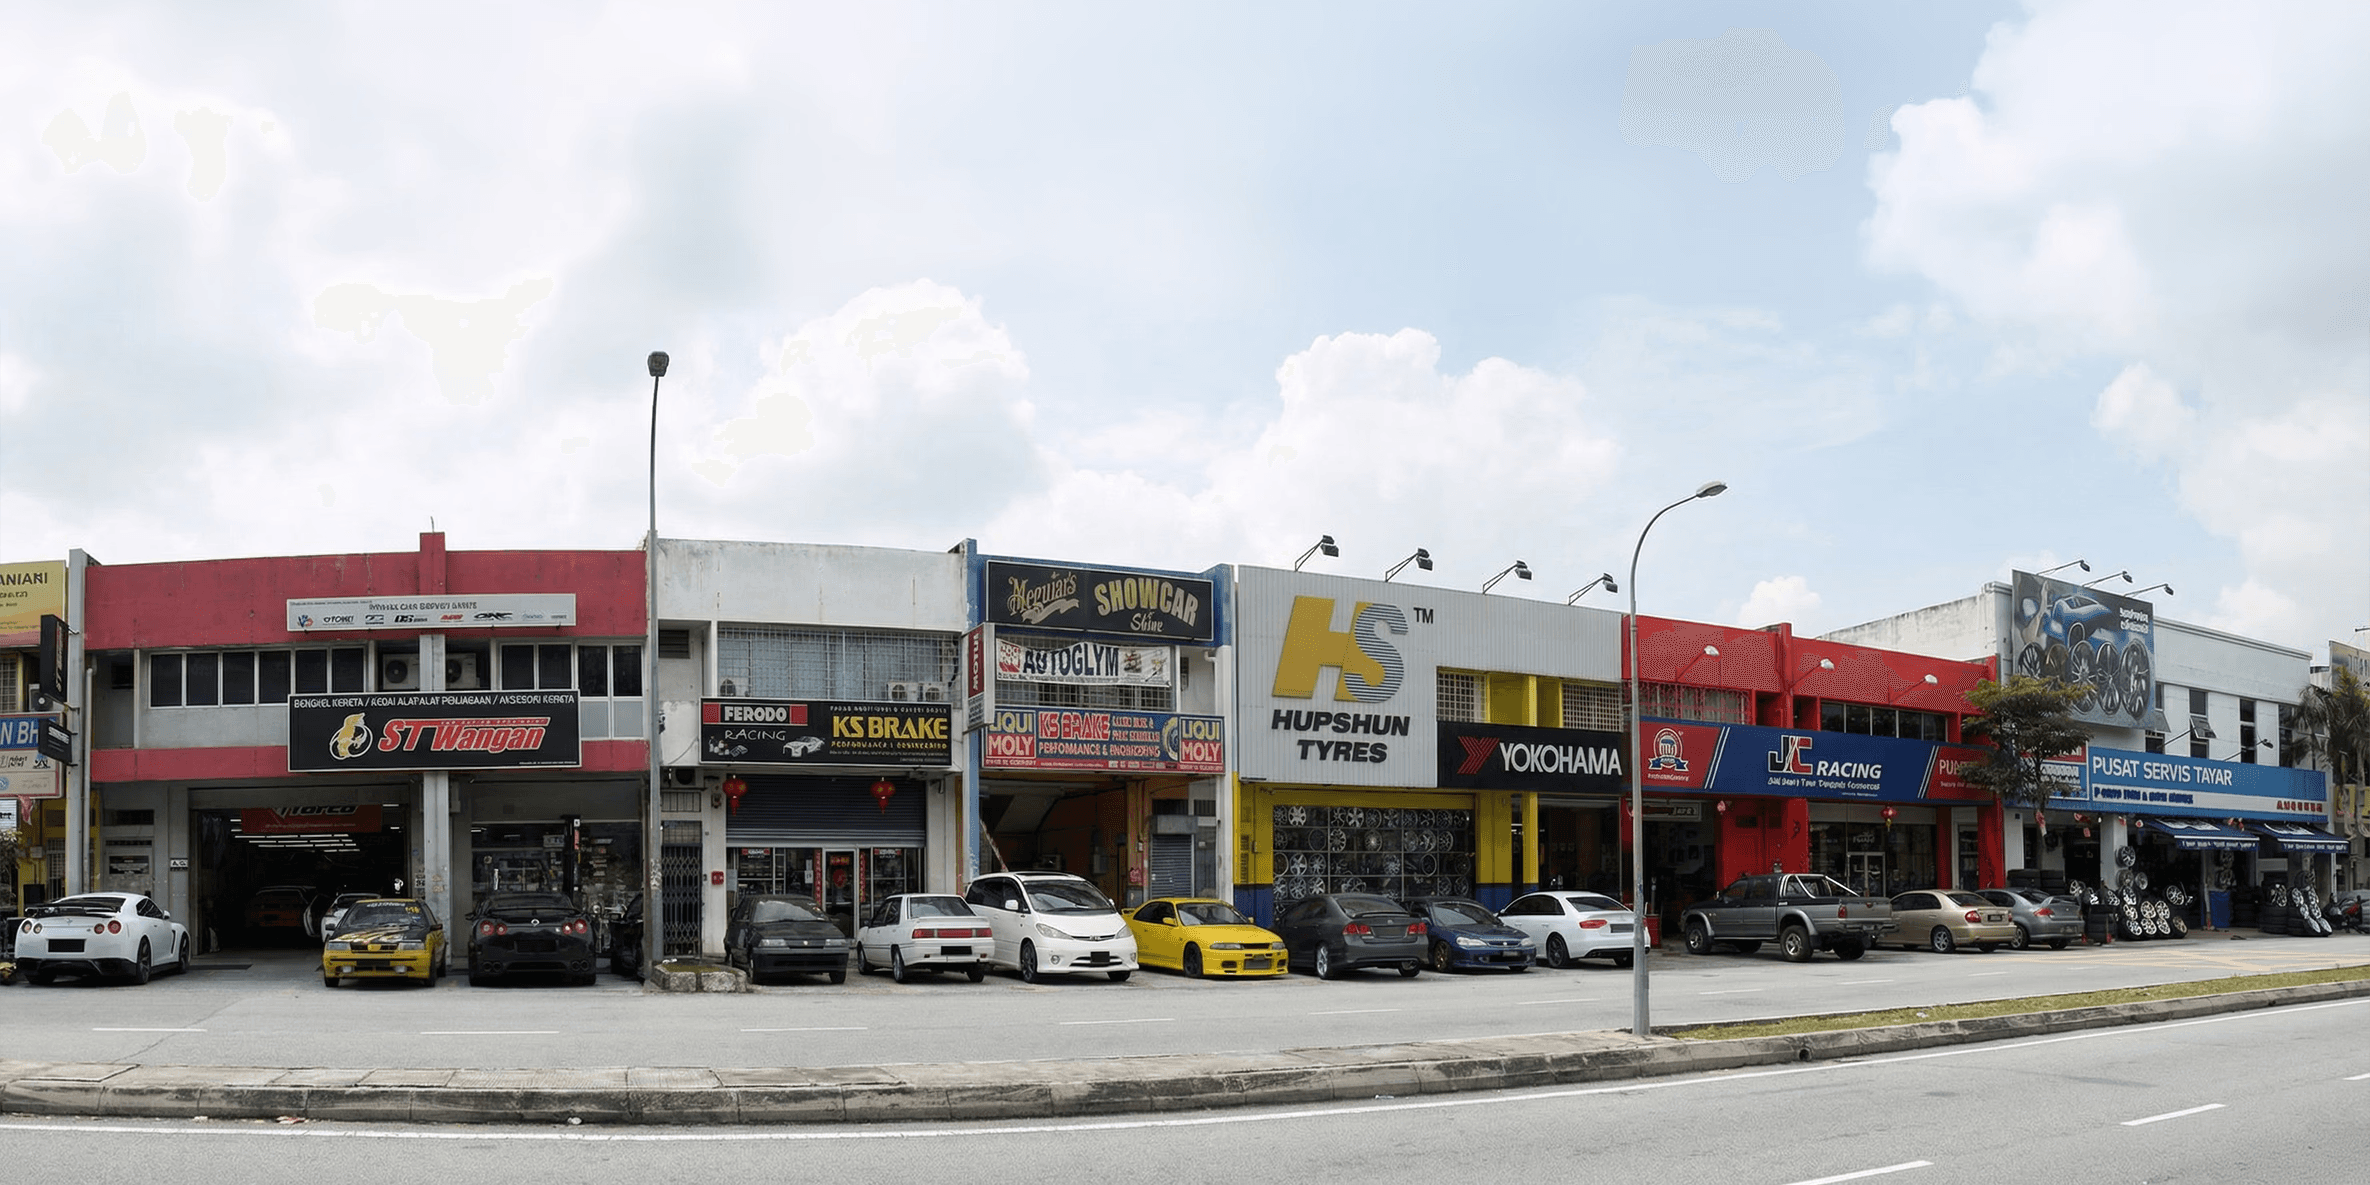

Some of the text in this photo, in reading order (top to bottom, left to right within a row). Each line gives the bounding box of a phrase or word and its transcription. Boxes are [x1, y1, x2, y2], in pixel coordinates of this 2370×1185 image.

[1094, 577, 1199, 627] SHOWCAR
[1413, 607, 1434, 624] TM
[1023, 643, 1119, 676] AUTOGLYM
[1272, 595, 1410, 704] HS
[332, 697, 364, 707] KERETA
[725, 706, 787, 722] FERODO
[1038, 711, 1060, 739] KS
[1271, 709, 1411, 736] HUPSHUN
[17, 721, 39, 744] BH
[725, 728, 786, 741] RACING
[833, 715, 948, 739] KS BRAKE
[1182, 720, 1220, 740] LIQUI
[431, 725, 546, 754] Wangan
[988, 735, 1034, 756] MOLY
[1182, 741, 1221, 762] MOLY
[1297, 740, 1388, 763] TYRES
[1499, 742, 1623, 776] YOKOHAMA
[1816, 760, 1882, 779] RACING
[2093, 755, 2140, 778] PUSAT
[2143, 761, 2191, 783] SERVIS
[2193, 765, 2233, 786] TAYAR
